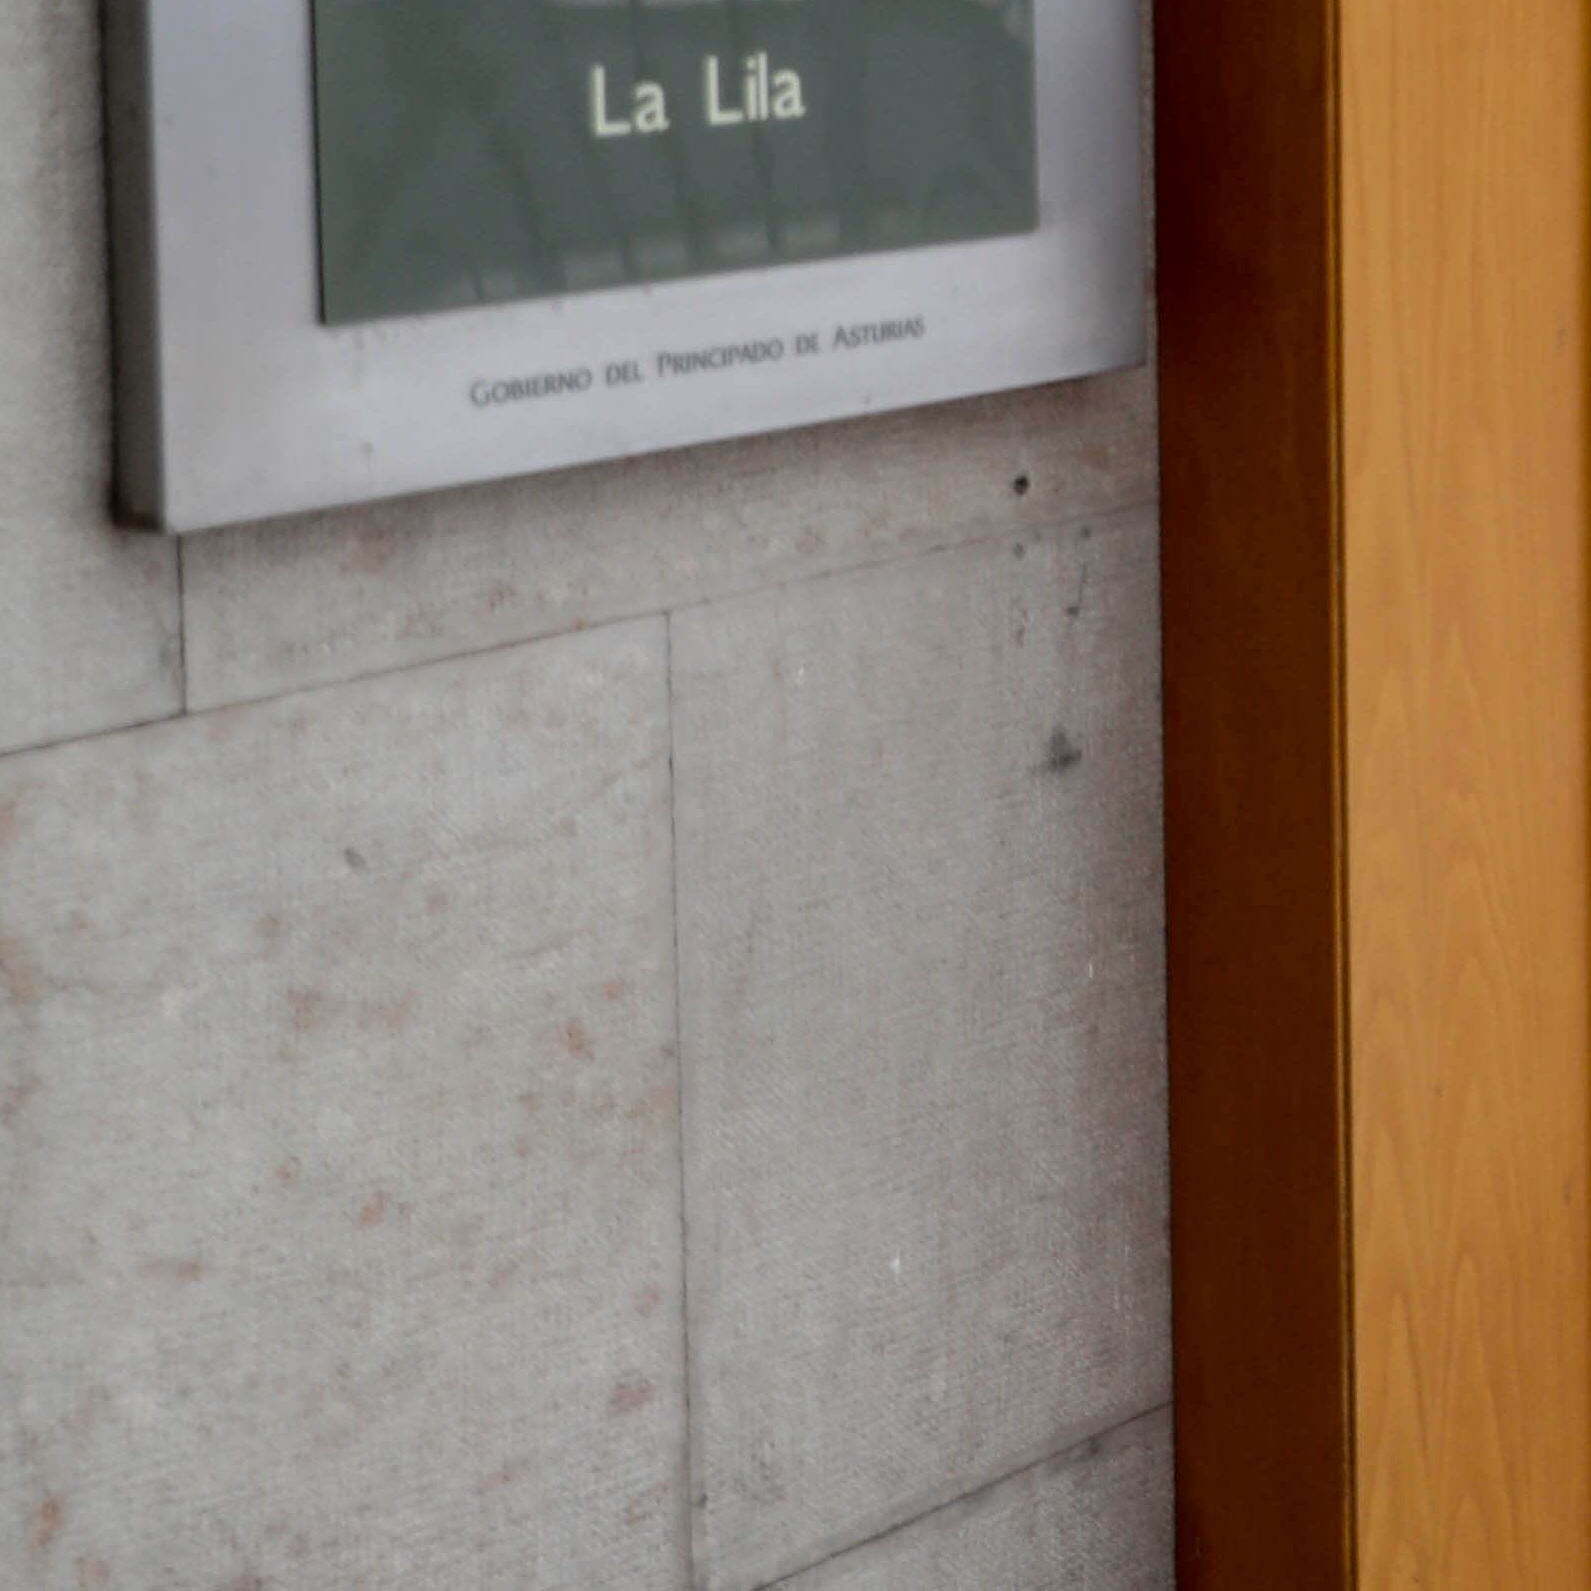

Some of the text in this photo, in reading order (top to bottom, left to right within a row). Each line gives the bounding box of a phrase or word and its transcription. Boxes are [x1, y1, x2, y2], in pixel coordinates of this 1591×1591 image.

[589, 52, 806, 139] La Lila
[469, 316, 926, 409] GOBIERNO DEL PRINCIPADO DE ASTURIAS
